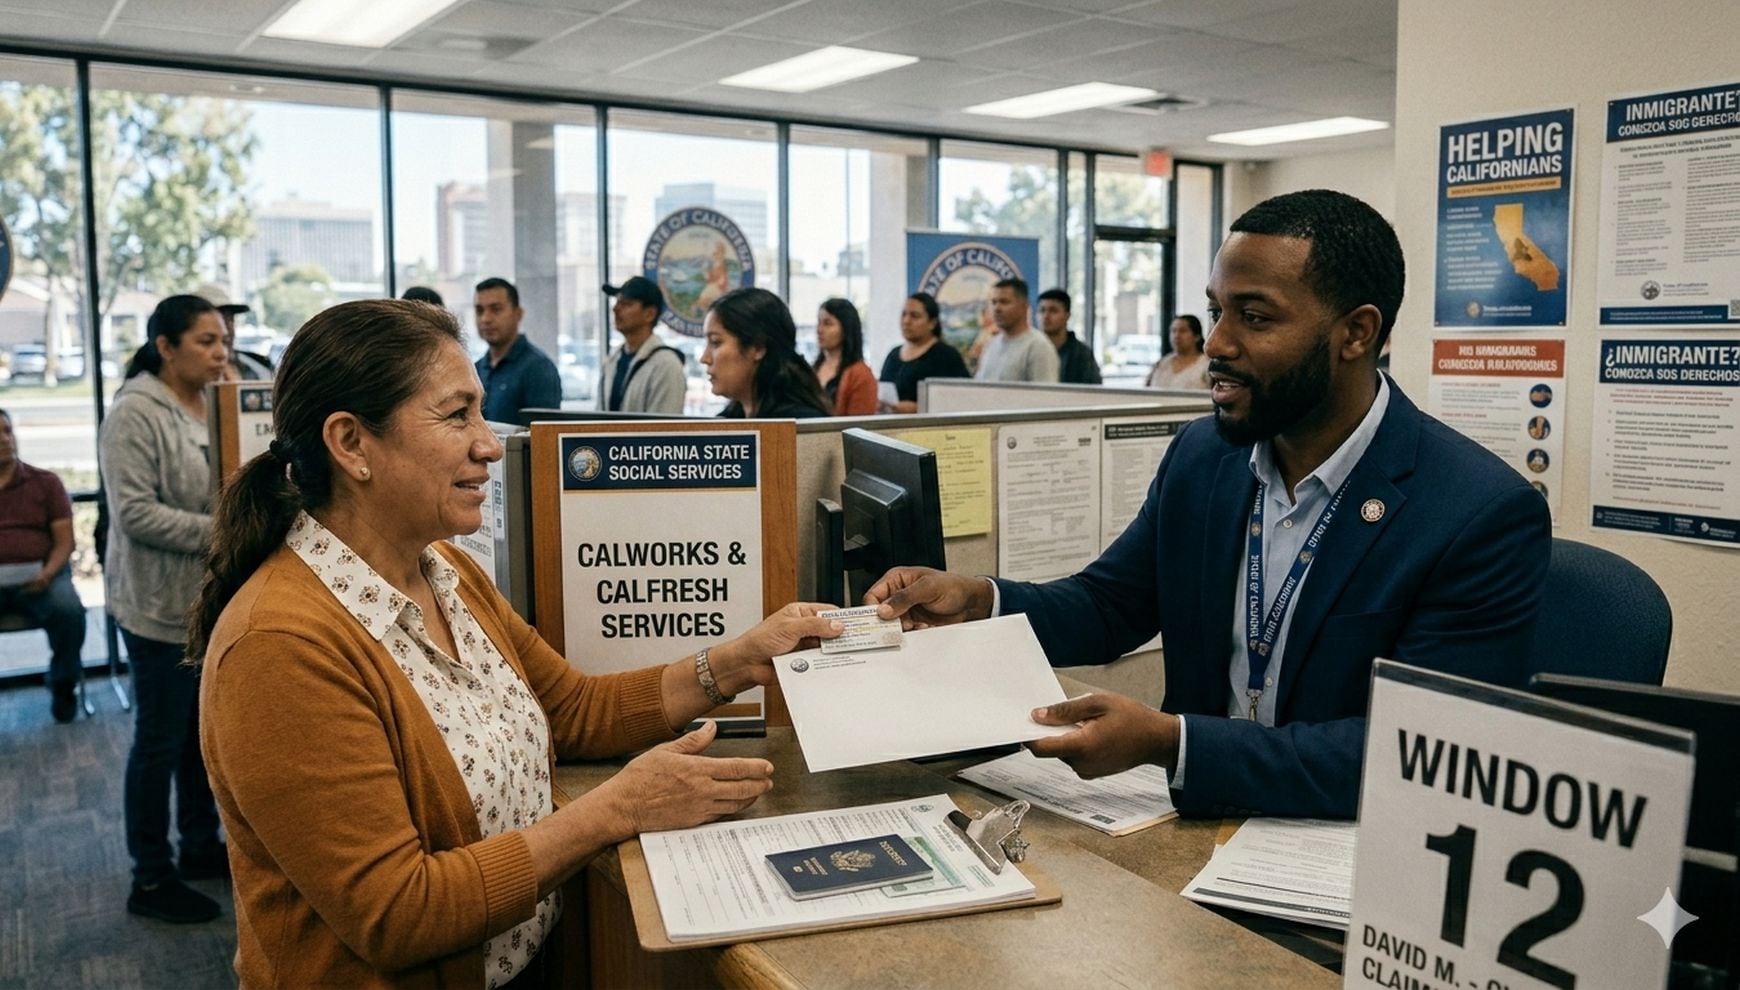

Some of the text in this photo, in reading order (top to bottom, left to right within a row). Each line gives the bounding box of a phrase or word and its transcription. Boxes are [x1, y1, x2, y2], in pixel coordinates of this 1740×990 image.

[1447, 122, 1563, 164] HELPING
[1446, 154, 1562, 183] CALIFORNIANS
[1605, 345, 1740, 367] ¿INMIGRANTE?
[1656, 368, 1678, 380] SOS
[1680, 369, 1740, 381] DERECHOS
[608, 444, 750, 461] CALIFORNIA STATE
[608, 463, 742, 481] SOCIAL SERVICES
[577, 541, 747, 568] CALWORKS &
[596, 577, 728, 605] CALFRESH
[601, 612, 726, 639] SERVICES
[1397, 727, 1649, 850] WINDOW
[1425, 823, 1585, 990] 12
[1362, 924, 1427, 971] DAVID
[1434, 955, 1460, 988] M.
[1362, 956, 1438, 990] CLAI
